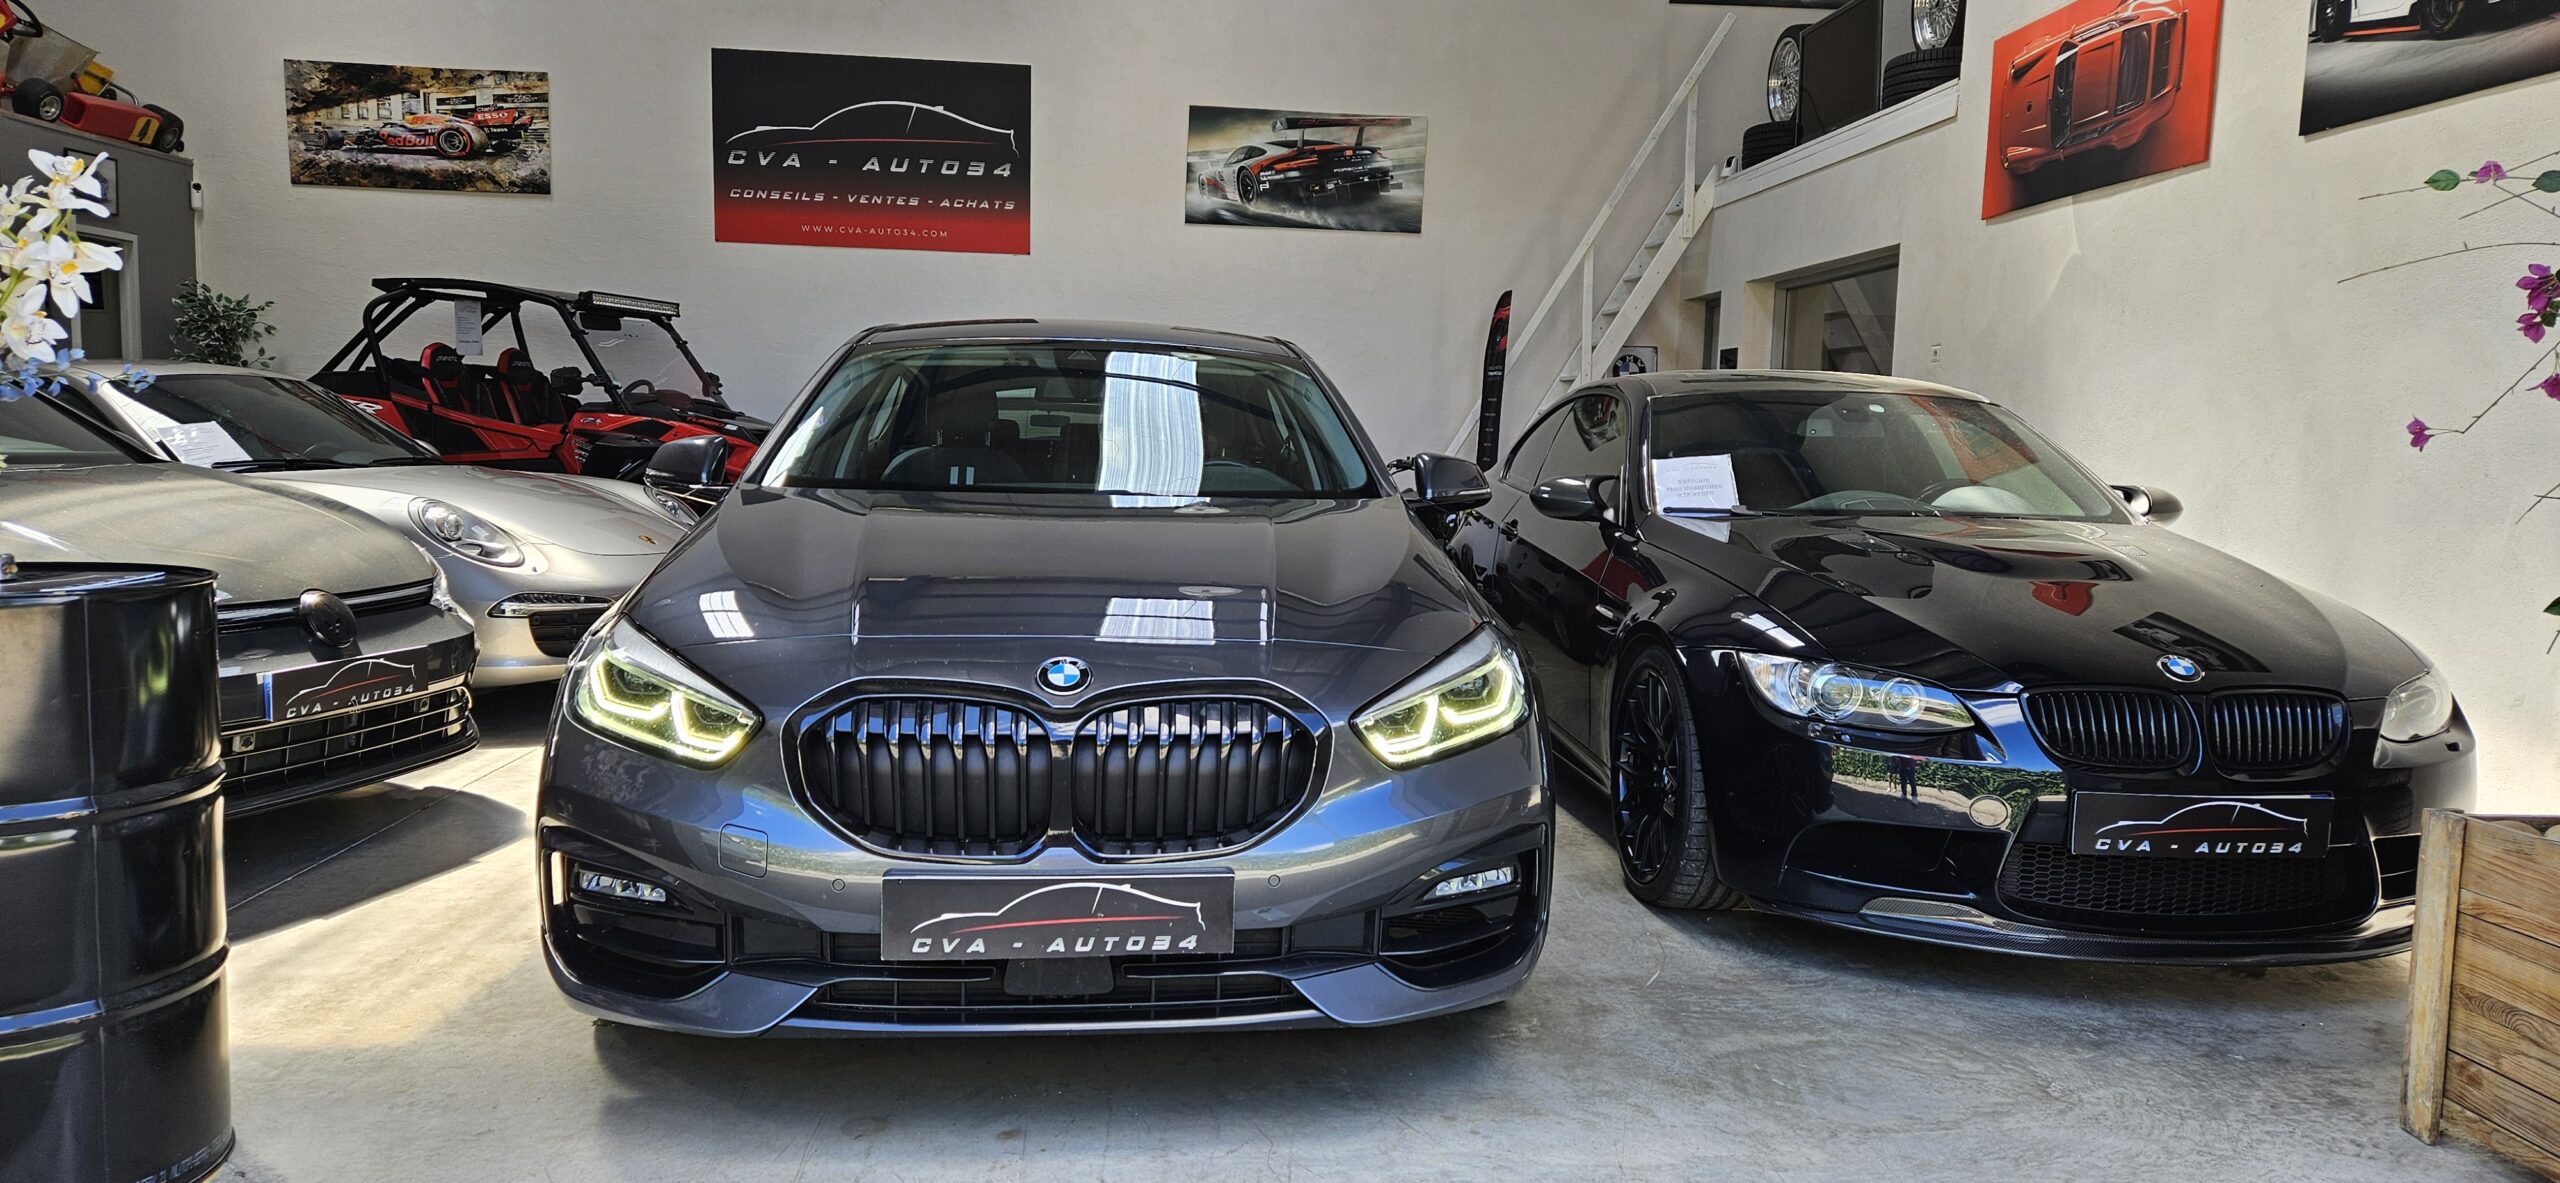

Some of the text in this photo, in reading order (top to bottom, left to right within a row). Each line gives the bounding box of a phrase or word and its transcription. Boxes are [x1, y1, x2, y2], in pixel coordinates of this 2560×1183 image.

[477, 112, 508, 120] ESSO
[136, 118, 152, 142] 4
[727, 150, 801, 168] CVA
[861, 156, 1012, 177] AUTO34
[729, 189, 825, 202] CONSEILS
[847, 193, 920, 206] VENTES
[939, 198, 1016, 210] ACHATS
[800, 224, 948, 238] WWW.CVA-AUTO34.COM
[1616, 355, 1644, 367] BMW
[286, 703, 322, 719] CVA
[348, 683, 414, 706] AUTO34
[2095, 838, 2151, 851] CVA
[2194, 842, 2302, 854] AUTO34
[911, 937, 986, 954] CVA
[1046, 934, 1198, 953] AUTO34
